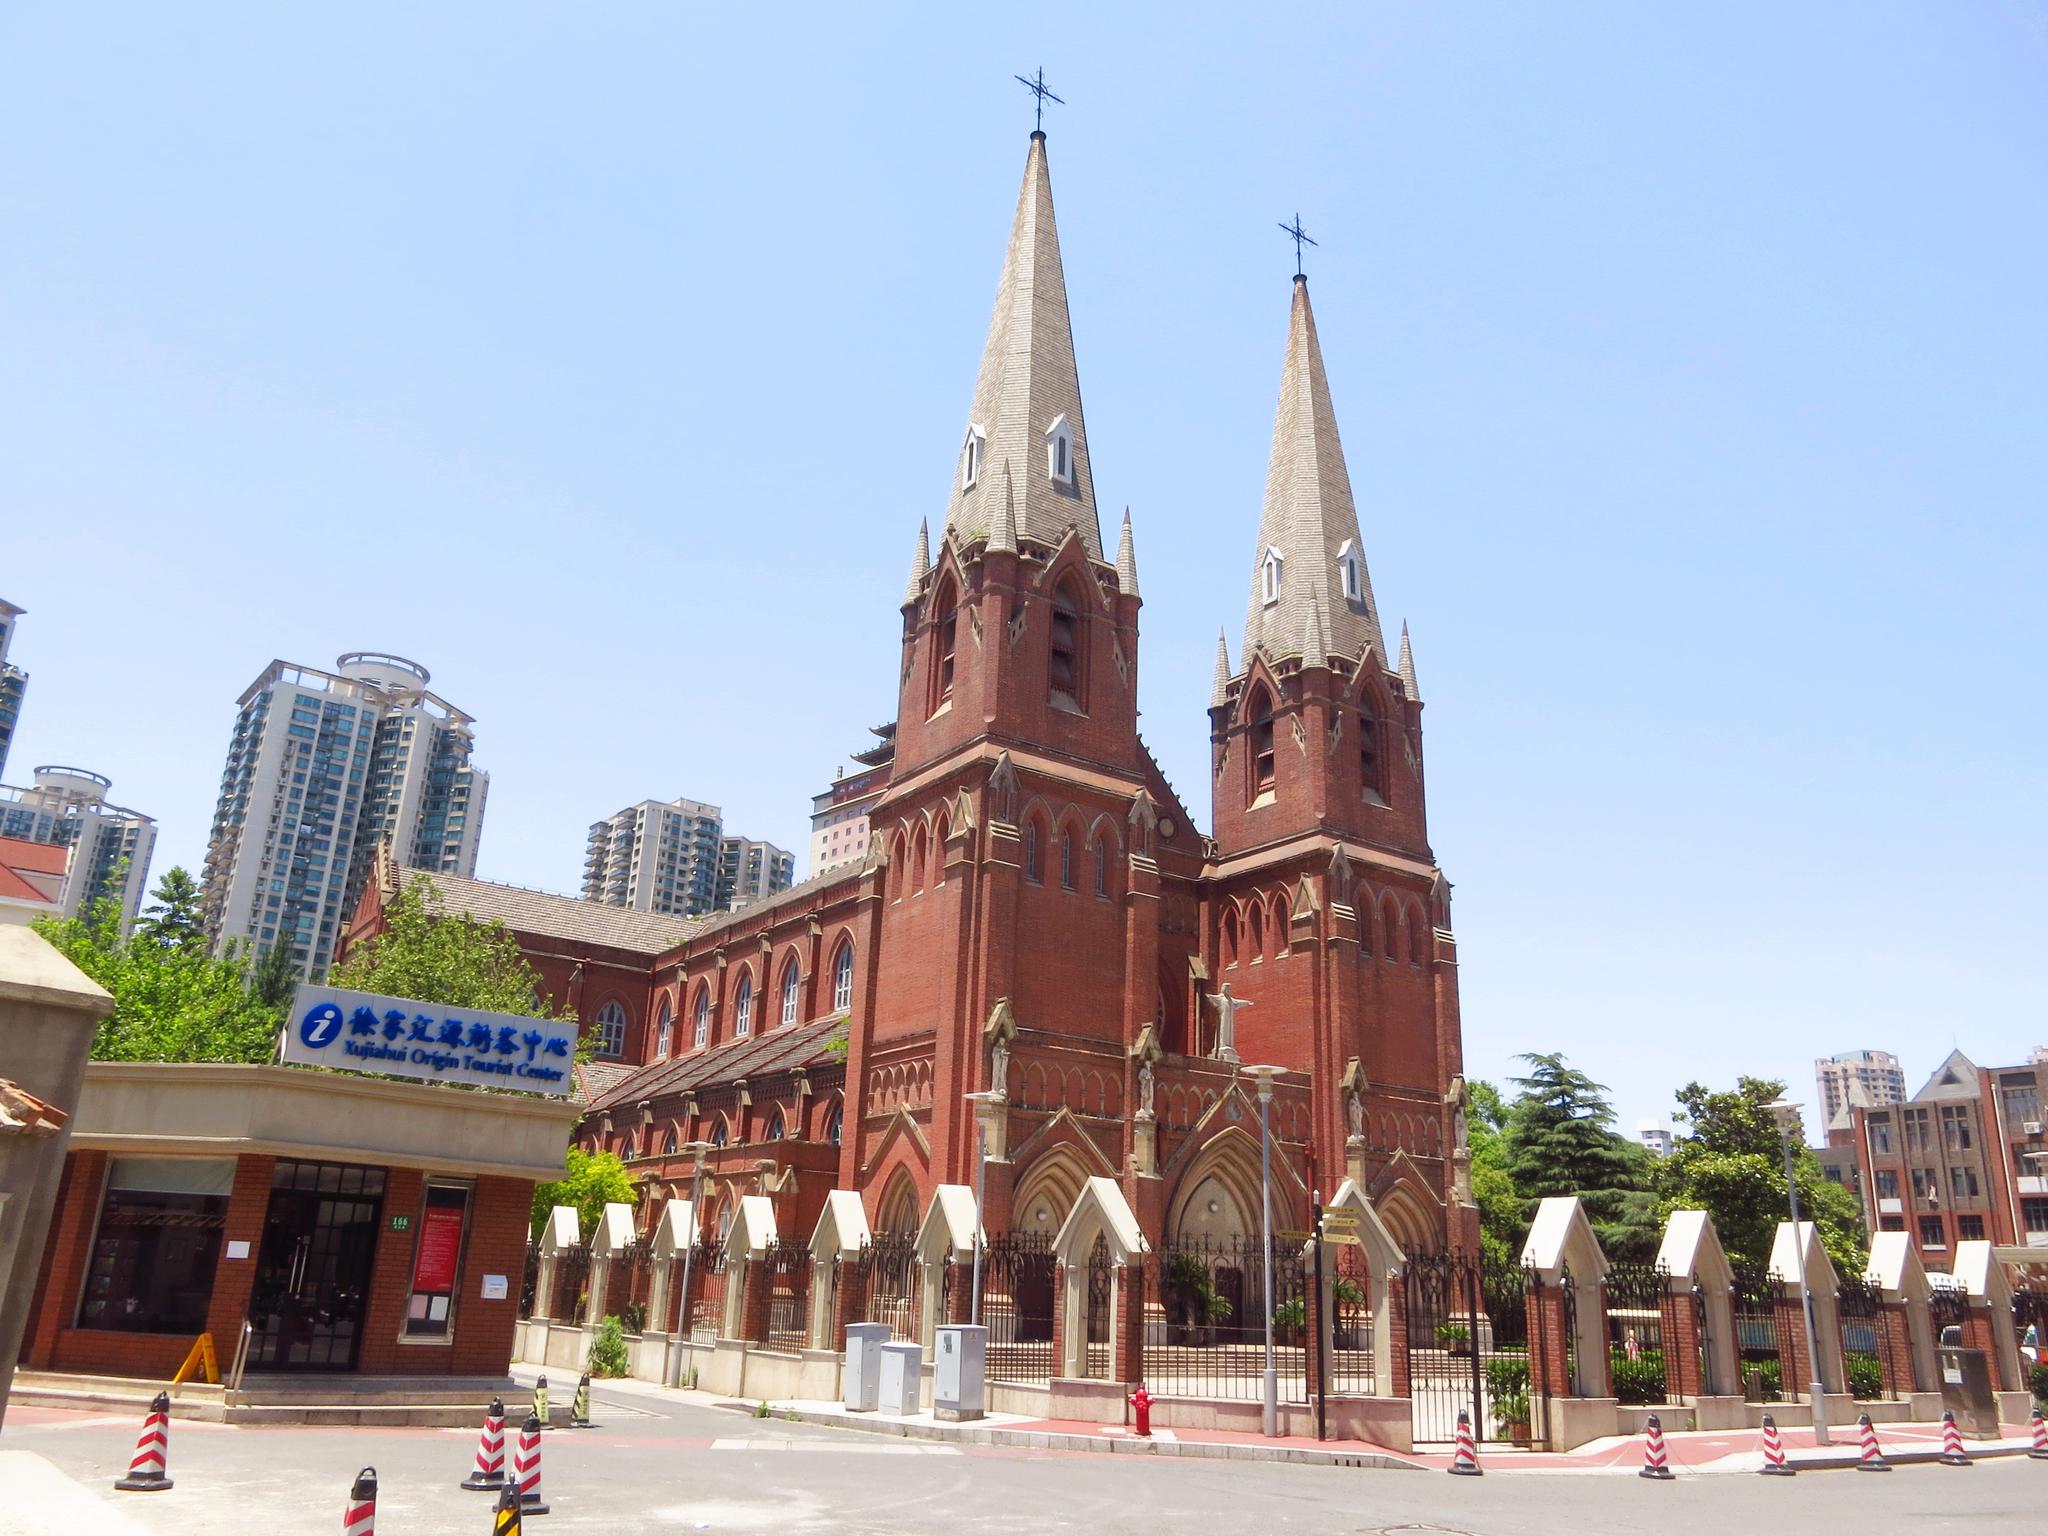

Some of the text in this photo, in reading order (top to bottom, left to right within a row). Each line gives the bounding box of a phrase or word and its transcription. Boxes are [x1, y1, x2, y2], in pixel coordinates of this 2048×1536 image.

[348, 1005, 569, 1062] 徐家汇源游客中心
[344, 1040, 564, 1082] Xujiahui Origin Tourist Center
[392, 1216, 408, 1225] 166
